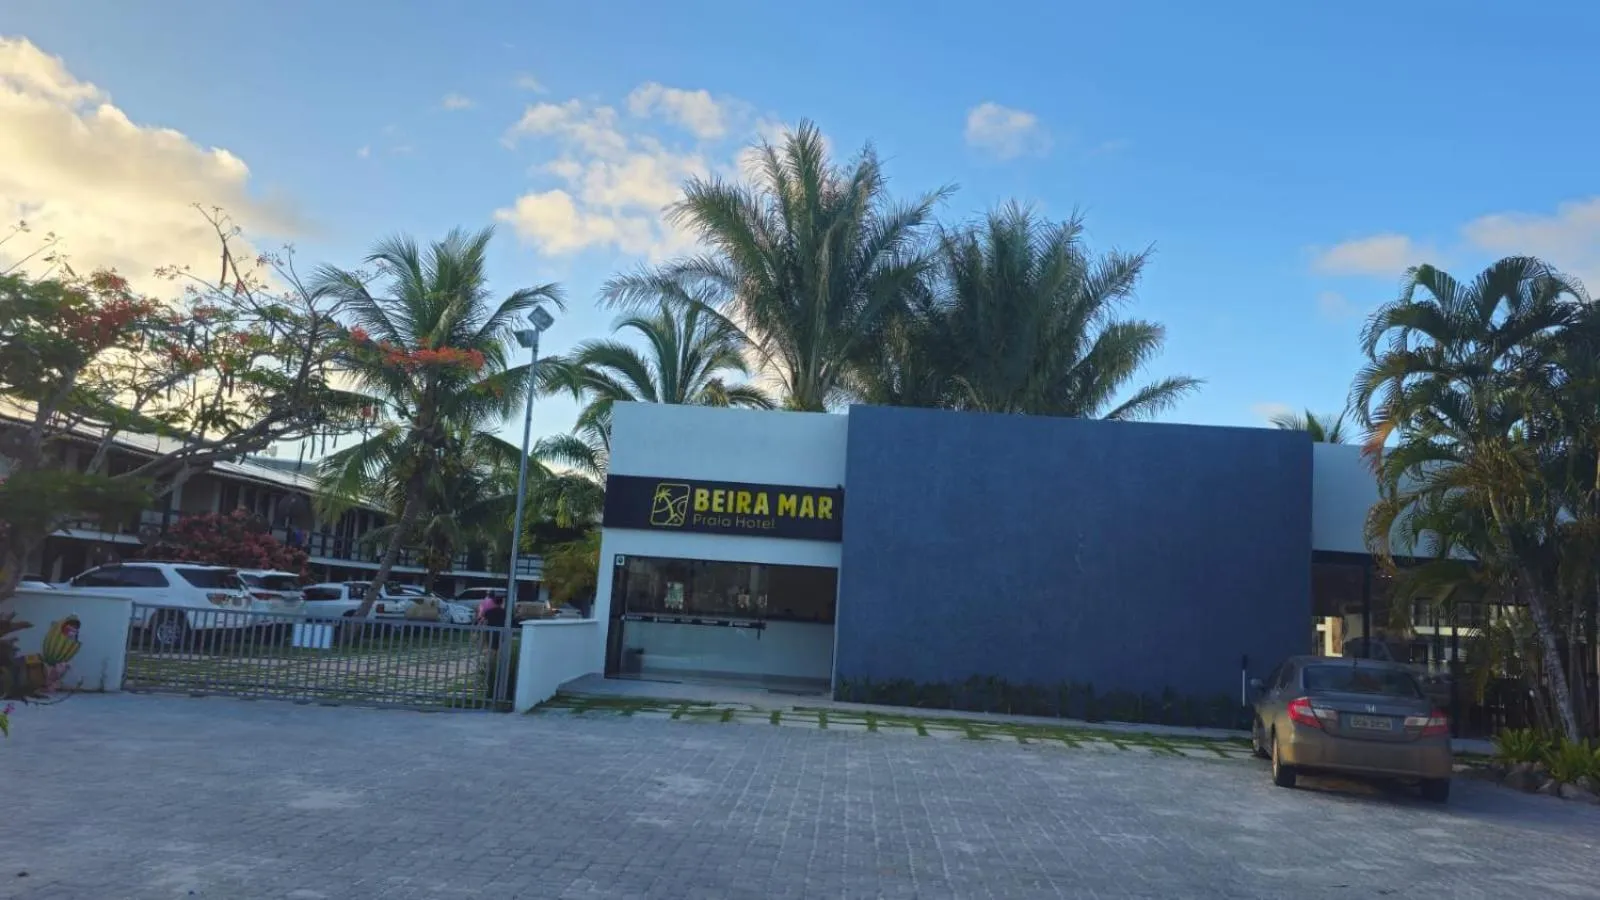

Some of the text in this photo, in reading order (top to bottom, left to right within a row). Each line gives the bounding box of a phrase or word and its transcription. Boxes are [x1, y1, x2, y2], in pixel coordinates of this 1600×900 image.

[694, 488, 833, 519] BEIRA MAR
[692, 513, 777, 529] Praia Hotel
